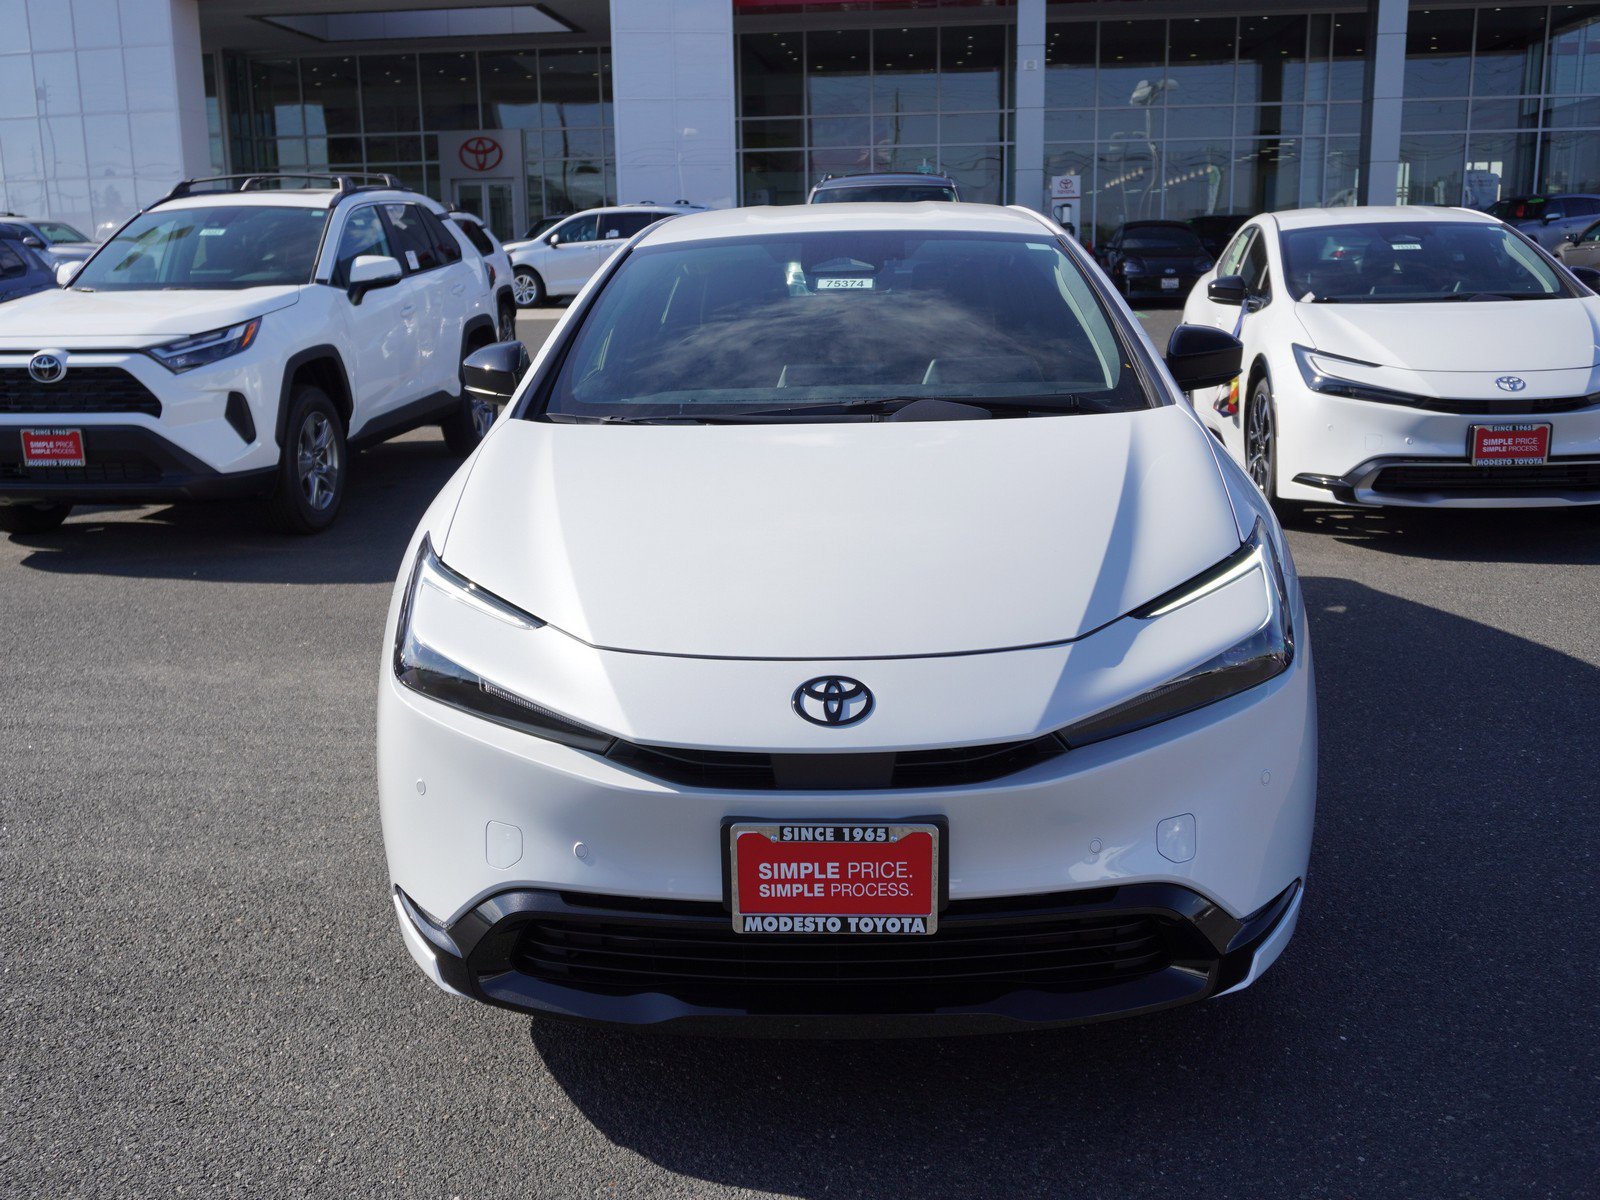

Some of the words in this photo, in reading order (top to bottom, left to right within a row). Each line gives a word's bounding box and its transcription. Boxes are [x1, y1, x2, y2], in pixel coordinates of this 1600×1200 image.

[782, 827, 834, 842] SINCE
[842, 827, 887, 842] 1965
[758, 862, 840, 880] SIMPLE
[848, 861, 913, 878] PRICE.
[759, 883, 825, 898] SIMPLE
[830, 882, 914, 897] PROCESS.
[744, 916, 841, 933] MODESTO
[848, 917, 926, 933] TOYOTA
